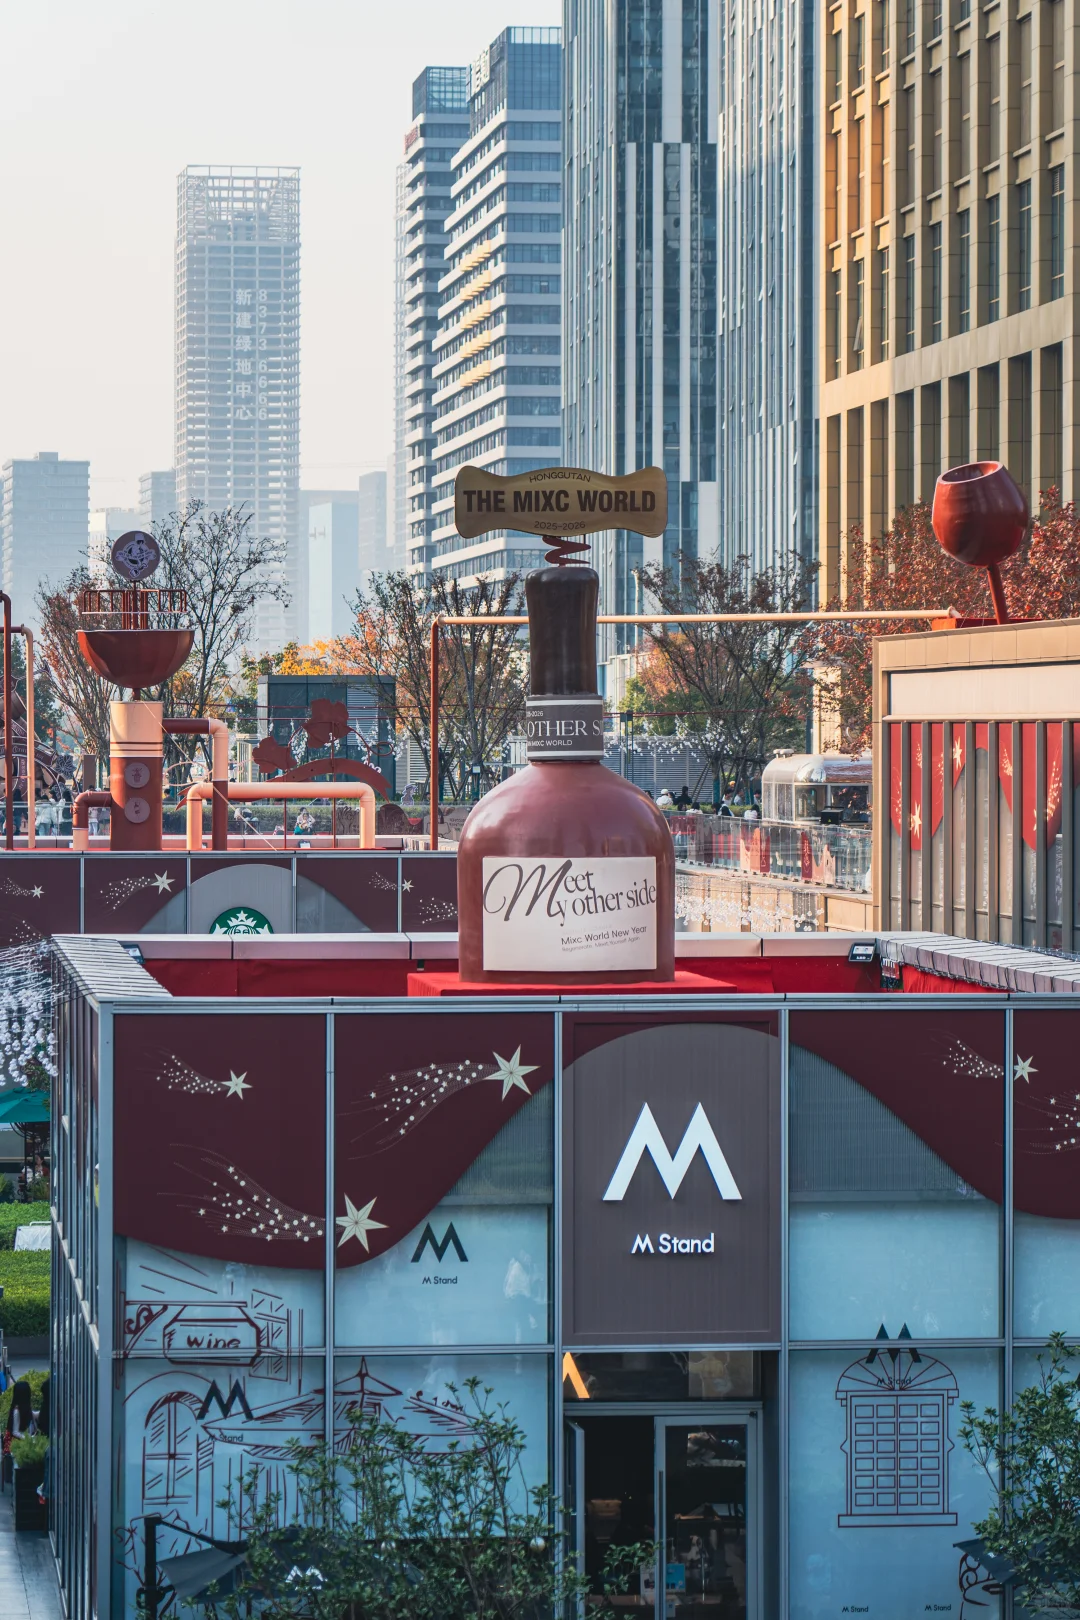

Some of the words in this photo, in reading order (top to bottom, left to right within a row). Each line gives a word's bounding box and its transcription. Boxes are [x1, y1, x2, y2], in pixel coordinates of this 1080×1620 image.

[235, 288, 253, 421] 新建绿地中心
[528, 471, 591, 483] HONGGUTAN
[463, 490, 506, 513] THE
[513, 490, 570, 513] MIXC
[577, 490, 656, 513] WORLD
[533, 521, 586, 531] 2025-2026
[527, 720, 588, 738] OTHER
[571, 886, 624, 917] other
[626, 878, 657, 909] side
[561, 936, 583, 945] Mixc
[584, 930, 610, 942] World
[611, 929, 630, 939] New
[631, 925, 647, 934] Year
[602, 1101, 743, 1201] M
[409, 1221, 469, 1263] M
[631, 1233, 655, 1254] M
[658, 1232, 715, 1254] Stand
[422, 1275, 432, 1285] M
[433, 1275, 458, 1285] Stand
[186, 1333, 241, 1349] wine
[196, 1379, 254, 1420] M
[219, 1433, 244, 1442] Stand
[850, 1605, 869, 1613] Stand
[933, 1603, 952, 1611] Stand
